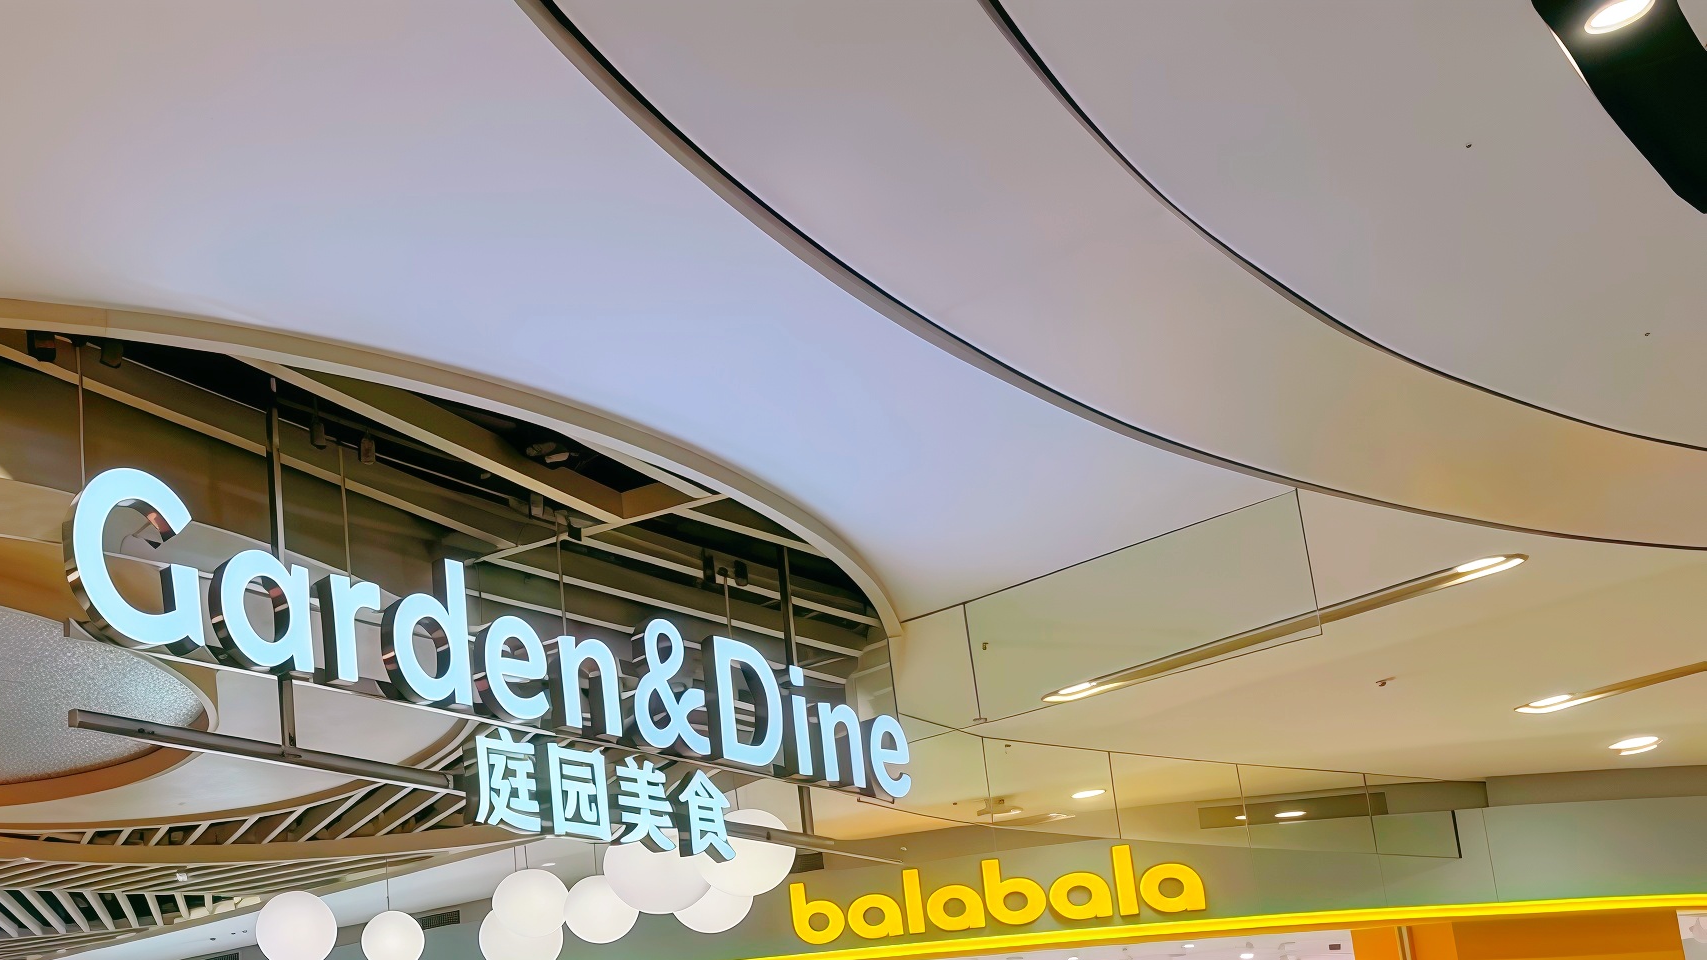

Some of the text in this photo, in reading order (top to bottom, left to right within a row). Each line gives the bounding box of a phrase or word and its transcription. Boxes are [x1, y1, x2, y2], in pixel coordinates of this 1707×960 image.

[71, 467, 915, 802] Garden&Dine
[475, 728, 737, 862] 庭园美食
[789, 845, 1207, 946] balabala
